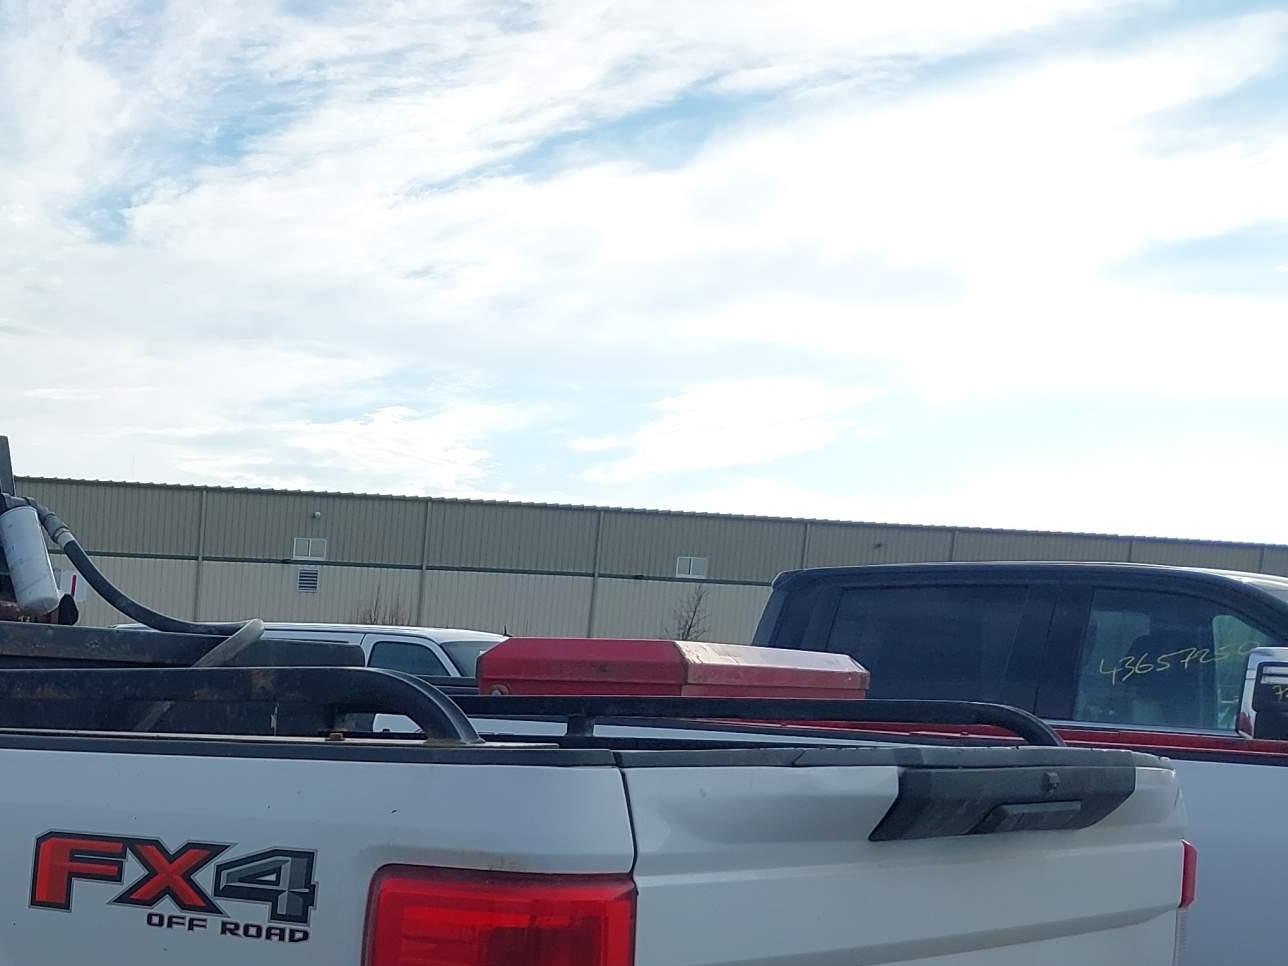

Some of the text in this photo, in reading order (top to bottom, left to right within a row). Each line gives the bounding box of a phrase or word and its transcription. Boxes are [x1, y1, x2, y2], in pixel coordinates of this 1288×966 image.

[29, 829, 318, 924] FX4
[146, 912, 309, 943] OFF ROAD
